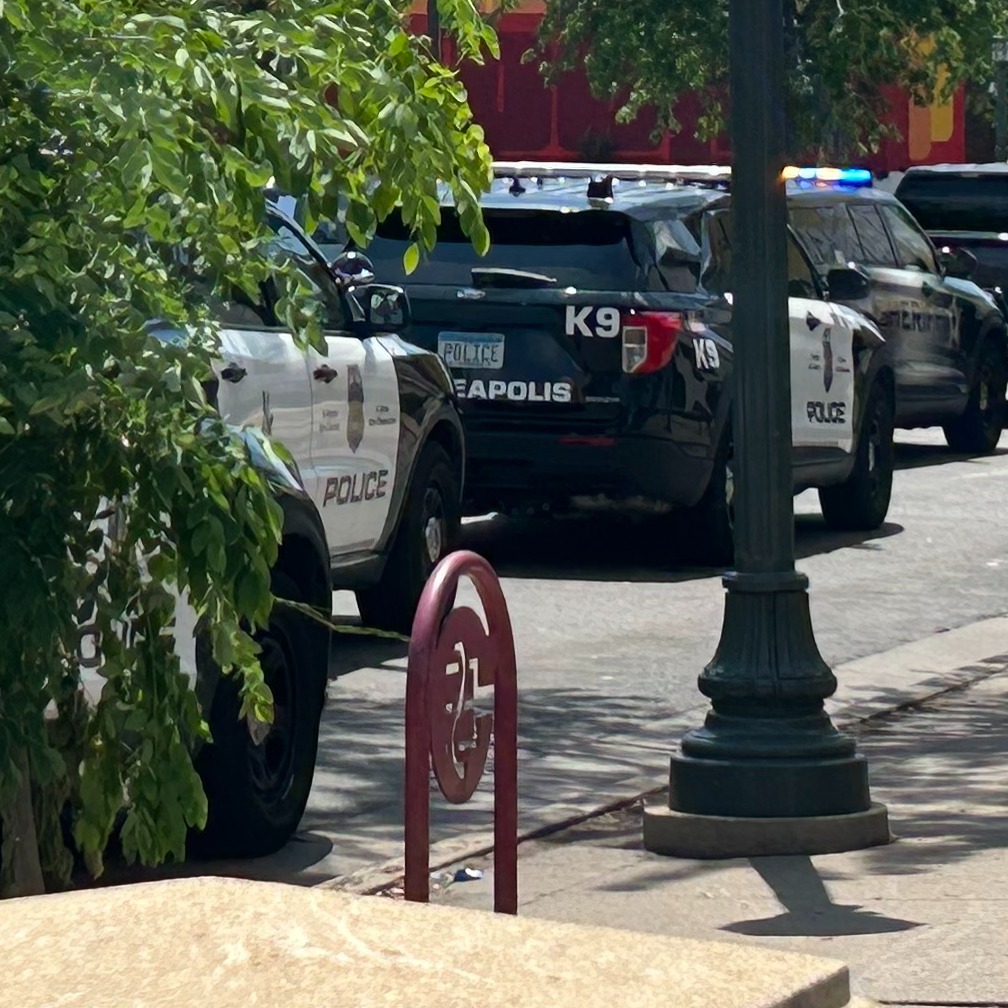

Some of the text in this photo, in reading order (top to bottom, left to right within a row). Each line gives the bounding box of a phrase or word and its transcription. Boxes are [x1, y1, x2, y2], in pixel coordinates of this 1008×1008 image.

[565, 305, 620, 339] K9
[443, 343, 499, 366] POLICE
[693, 338, 720, 369] K9
[806, 401, 846, 424] POLICE
[323, 469, 389, 508] POLICE
